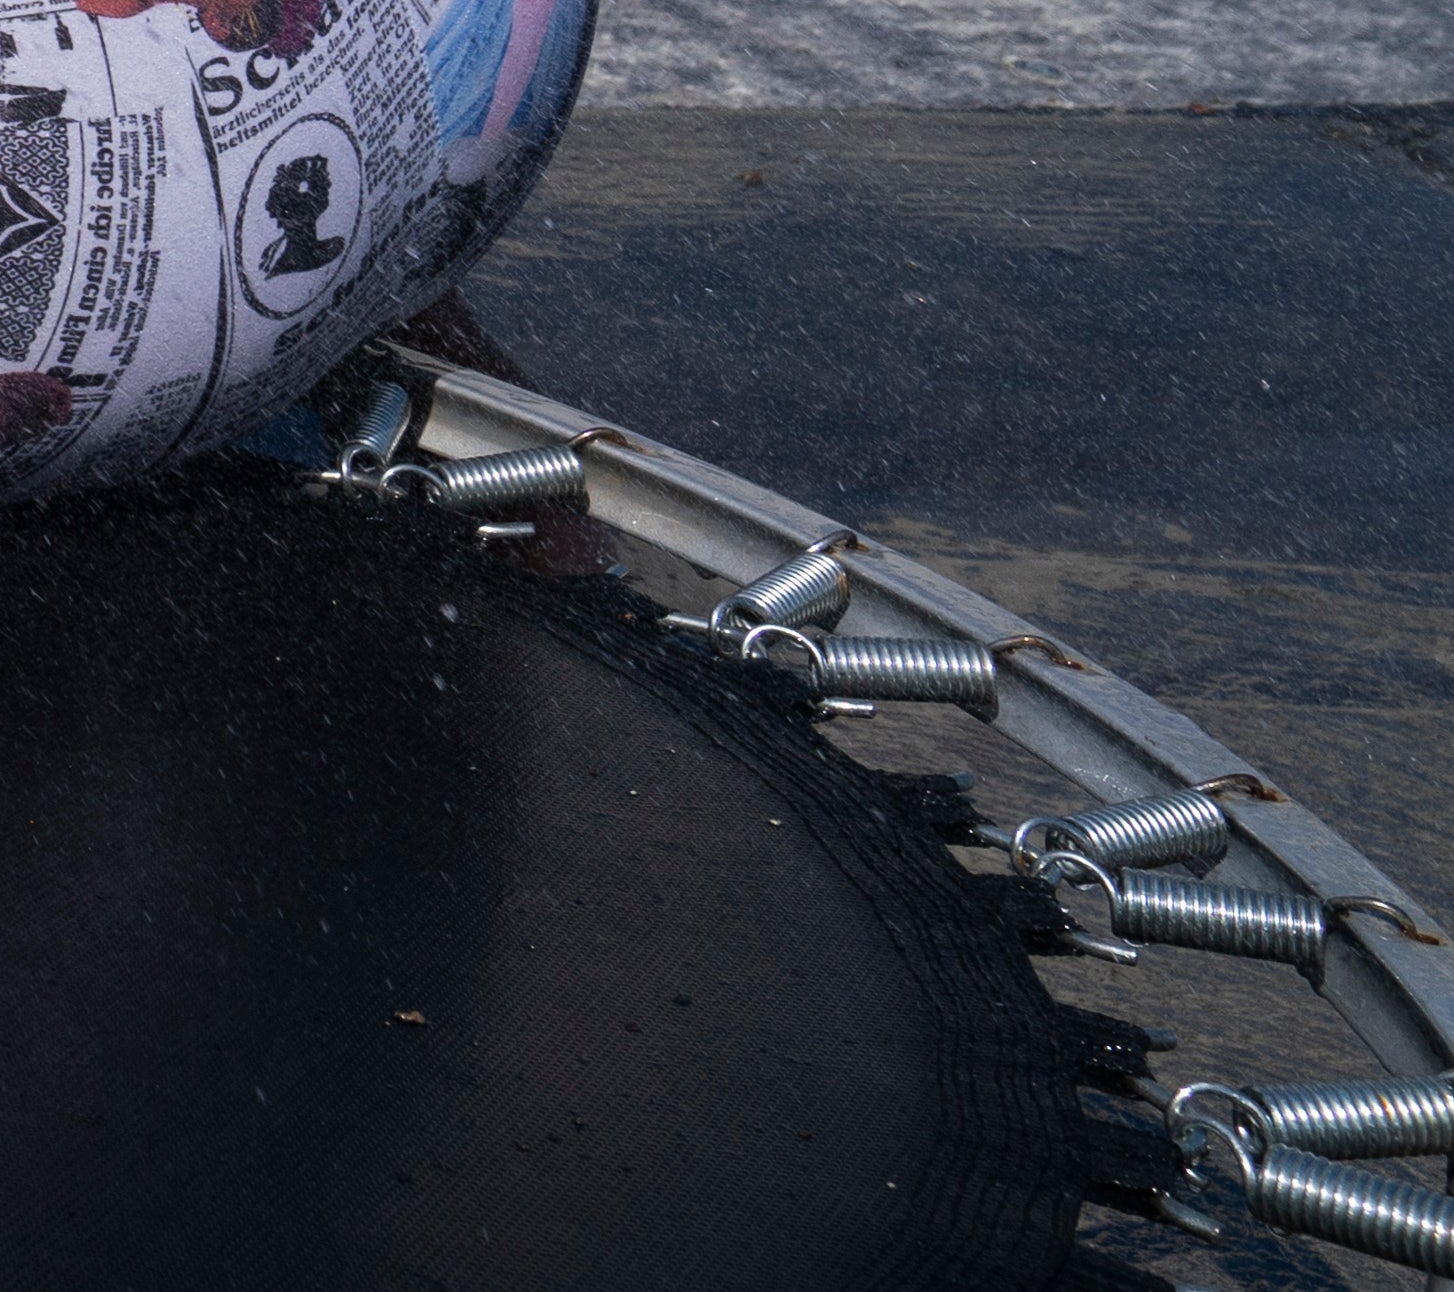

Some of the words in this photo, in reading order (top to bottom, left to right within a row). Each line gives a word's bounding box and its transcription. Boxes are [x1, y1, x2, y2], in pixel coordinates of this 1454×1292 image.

[212, 72, 306, 138] ärztlicherseits
[307, 54, 325, 74] als
[326, 30, 346, 55] das
[216, 92, 302, 154] heitsmittel
[303, 26, 365, 94] bezeichnet.
